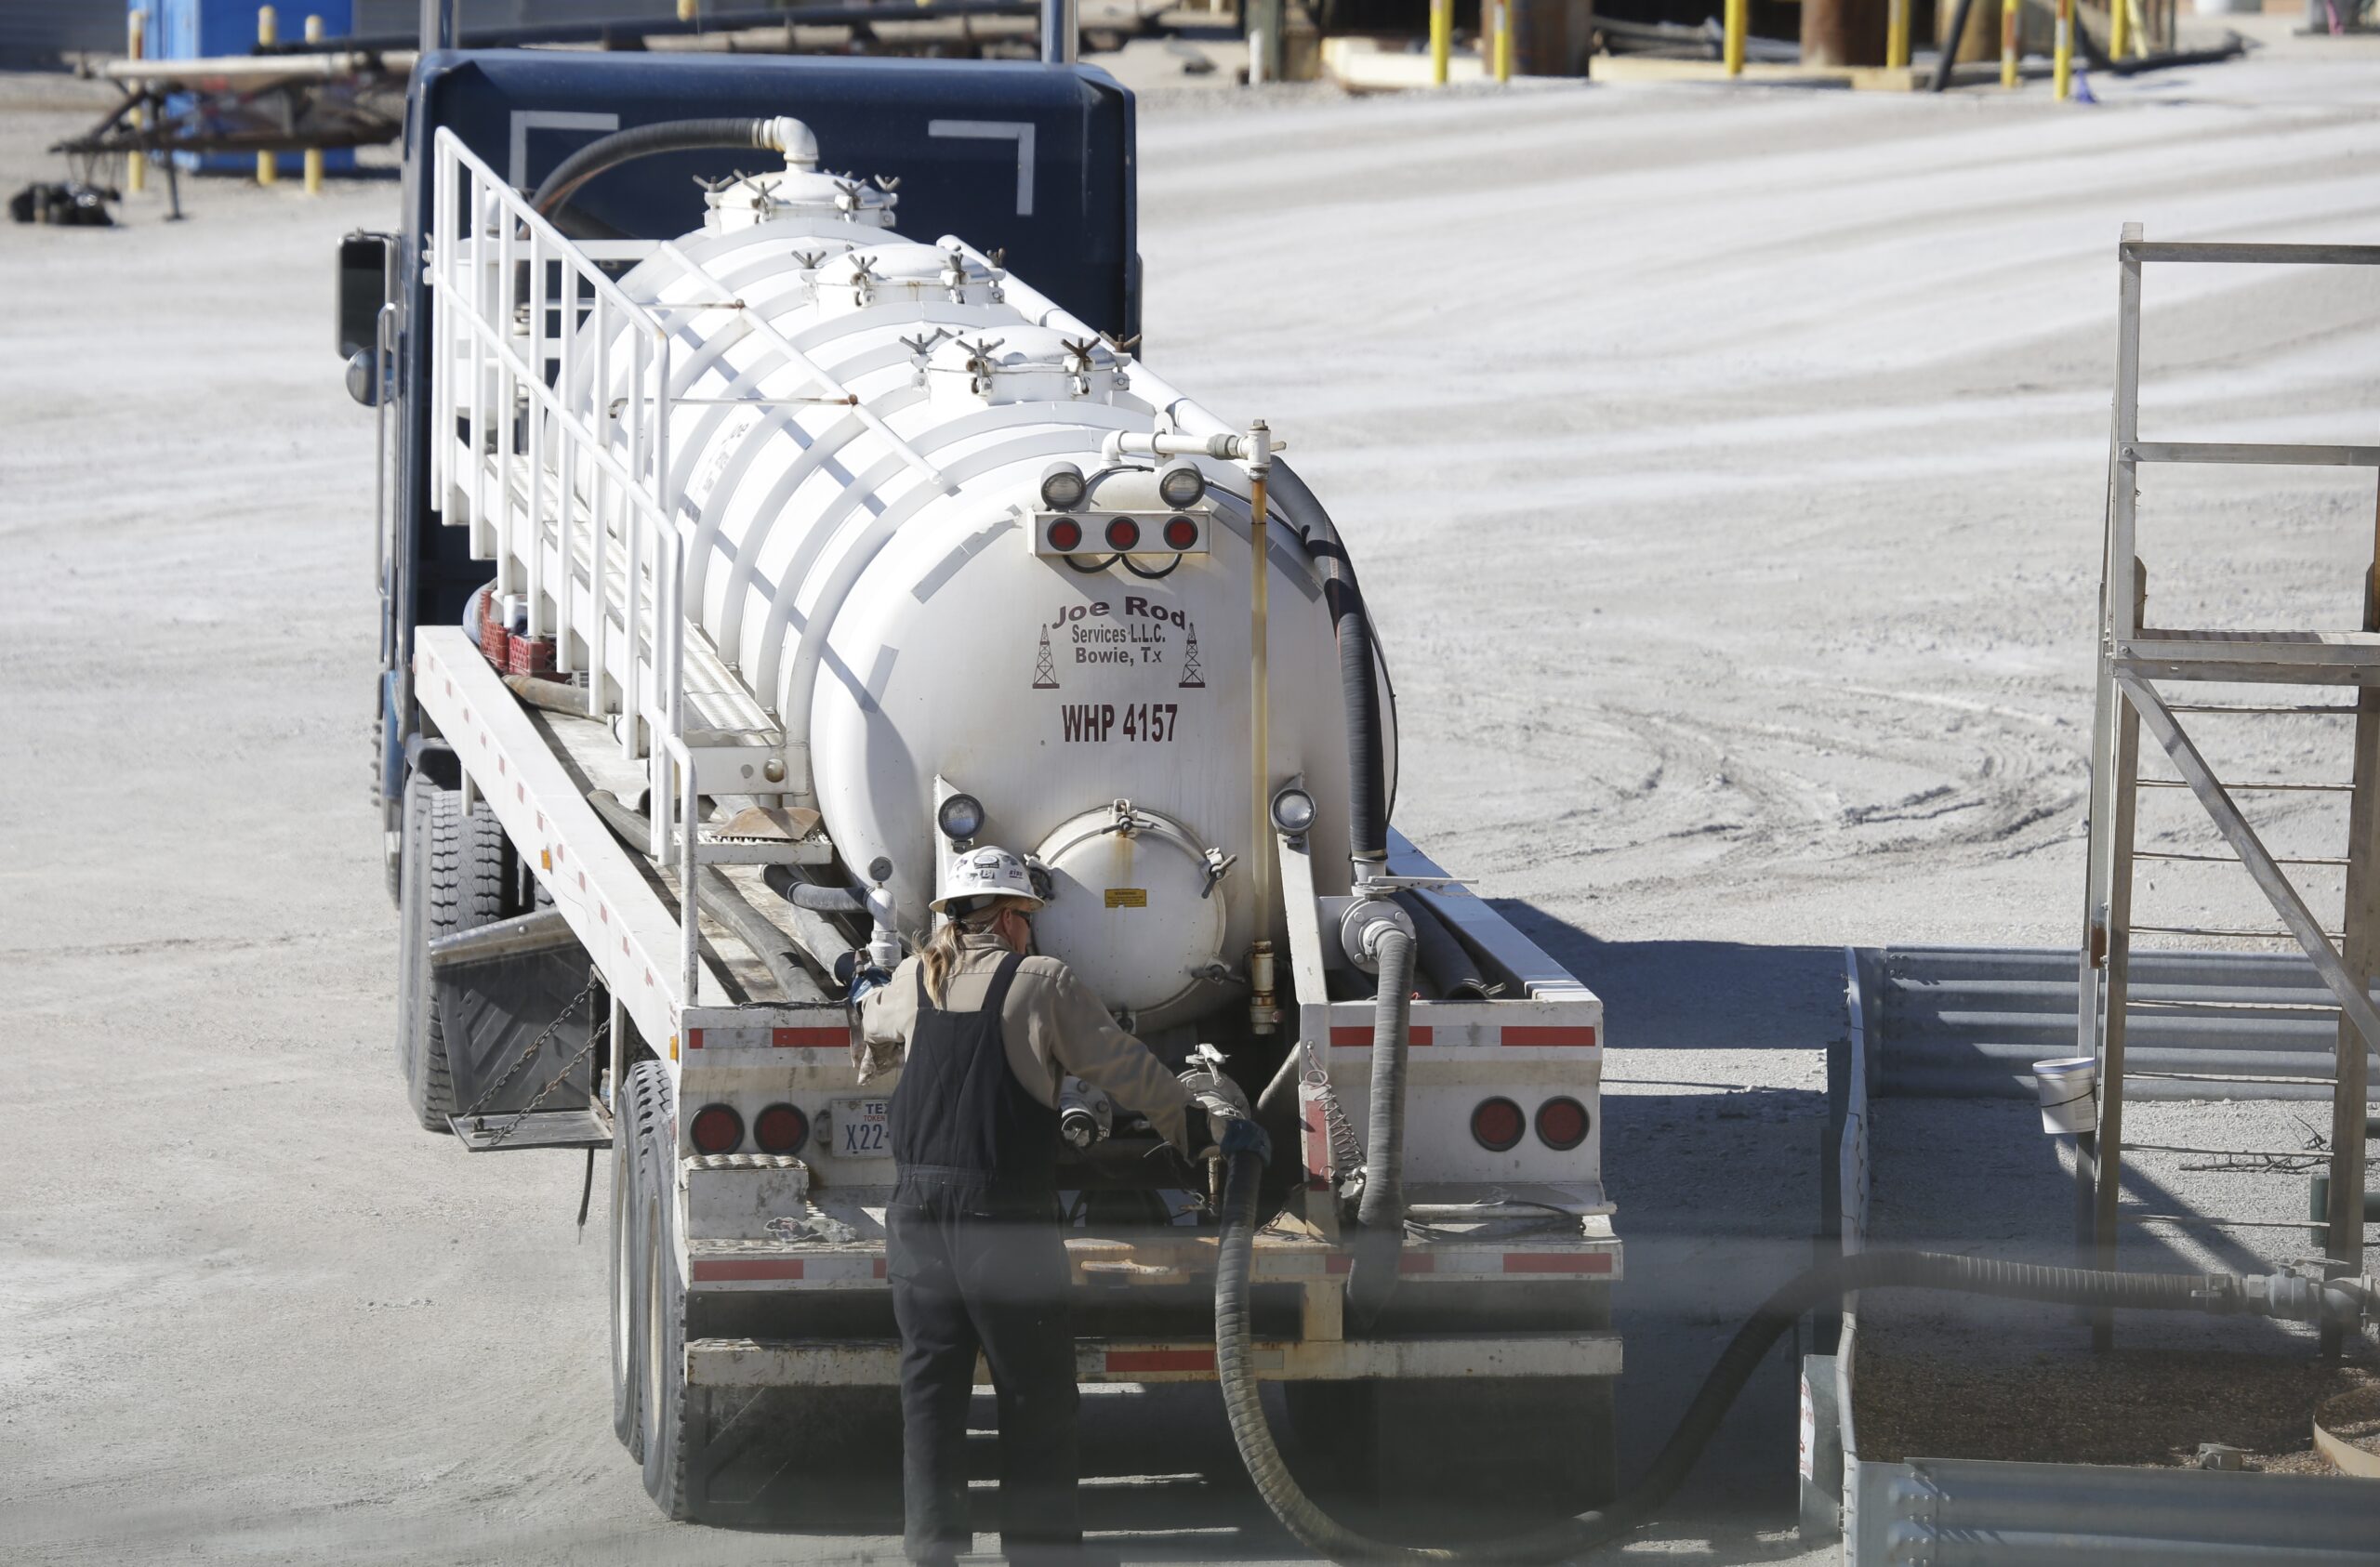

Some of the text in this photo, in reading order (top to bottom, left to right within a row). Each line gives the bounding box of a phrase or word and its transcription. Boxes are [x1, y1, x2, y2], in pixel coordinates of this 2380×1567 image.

[1051, 596, 1185, 630] Joe Rod
[1072, 624, 1166, 643] Services L.L.C.
[1076, 647, 1162, 666] Bowie, Tx
[1062, 704, 1178, 742] WHP 4157
[846, 1124, 890, 1151] X22
